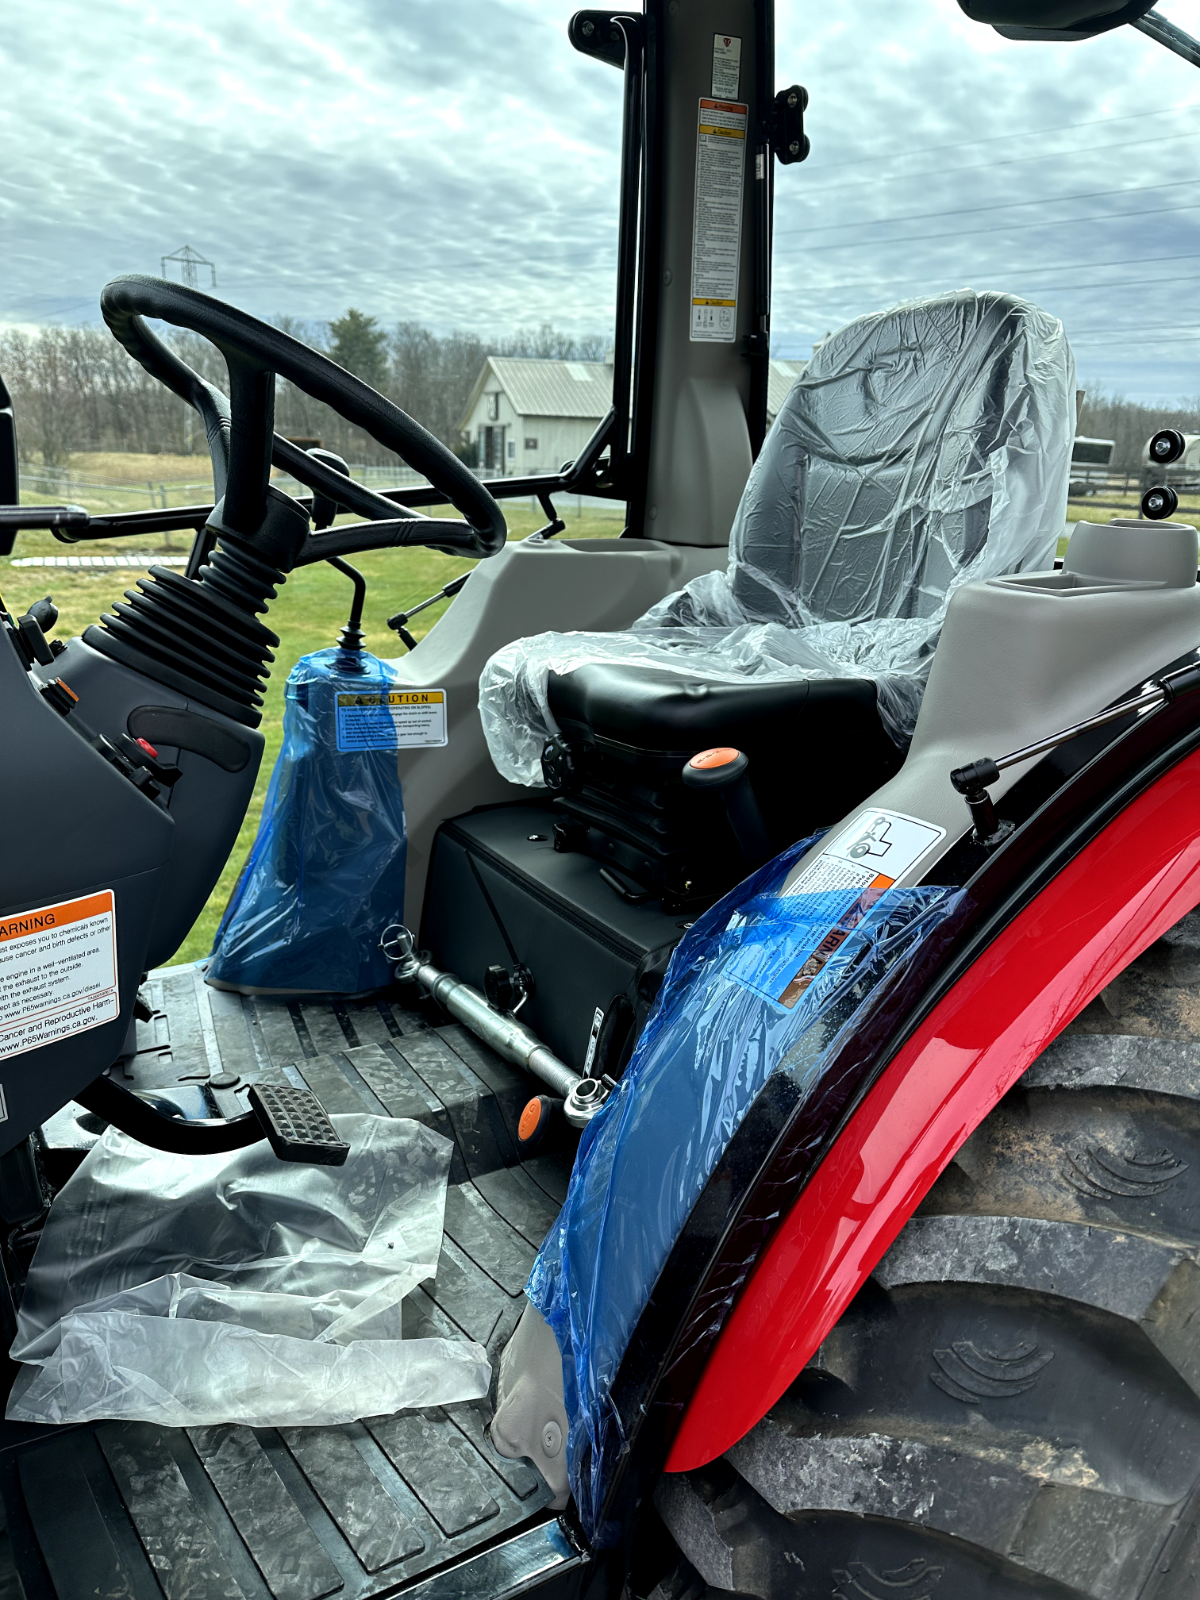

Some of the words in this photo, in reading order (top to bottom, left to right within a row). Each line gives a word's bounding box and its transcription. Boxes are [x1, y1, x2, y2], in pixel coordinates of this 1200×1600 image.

[0, 913, 55, 937] ARNING
[9, 939, 37, 951] exposes
[38, 935, 50, 944] you
[51, 932, 58, 940] to
[59, 923, 89, 937] chemicals
[90, 917, 109, 928] known
[15, 948, 37, 959] cancer
[39, 943, 51, 952] and
[52, 939, 66, 949] birth
[67, 932, 89, 944] defects
[97, 924, 112, 934] other
[3, 983, 14, 991] the
[15, 975, 40, 988] exhaust
[49, 970, 59, 978] the
[60, 962, 84, 974] outside.
[6, 970, 28, 980] engine
[30, 966, 36, 974] in
[43, 950, 86, 970] well-ventilated
[87, 947, 101, 956] area.
[10, 991, 21, 999] the
[22, 982, 47, 995] exhaust
[48, 975, 71, 987] system.
[12, 1000, 20, 1008] as
[21, 990, 55, 1005] necessary.
[28, 1021, 43, 1033] and
[44, 1005, 92, 1028] Reproductive
